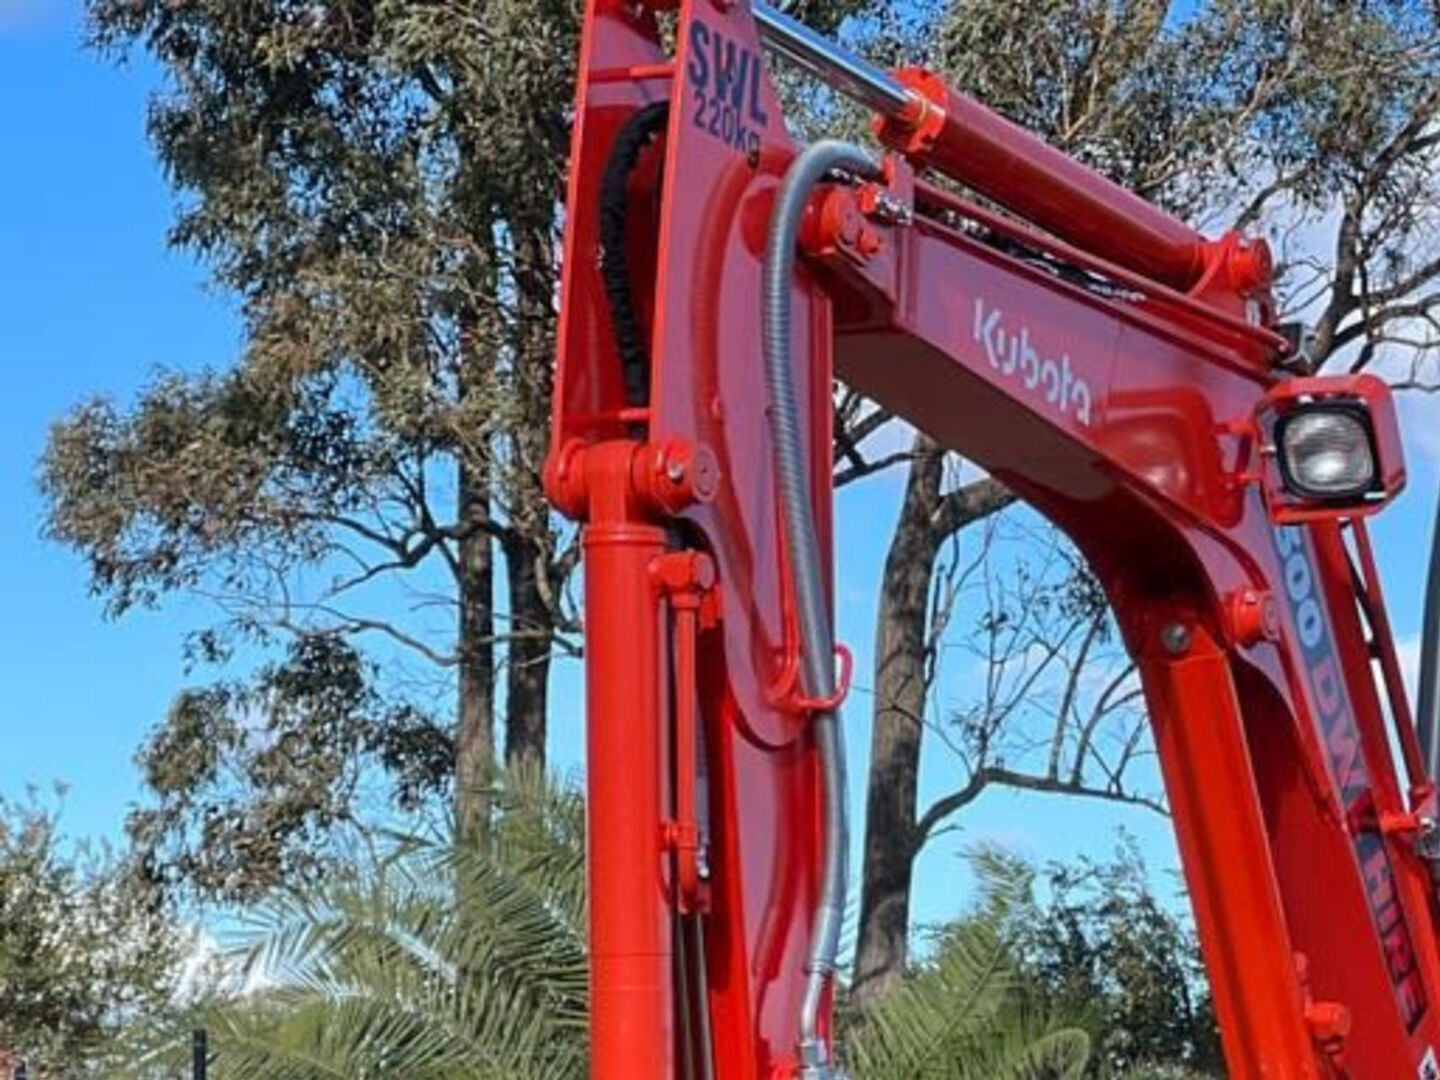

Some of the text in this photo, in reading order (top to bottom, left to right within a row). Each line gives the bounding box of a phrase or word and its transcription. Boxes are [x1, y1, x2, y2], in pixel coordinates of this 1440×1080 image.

[688, 20, 767, 125] SWL
[693, 90, 760, 168] 220kg
[973, 299, 1091, 428] Kubota
[1362, 848, 1428, 1026] HIRE
